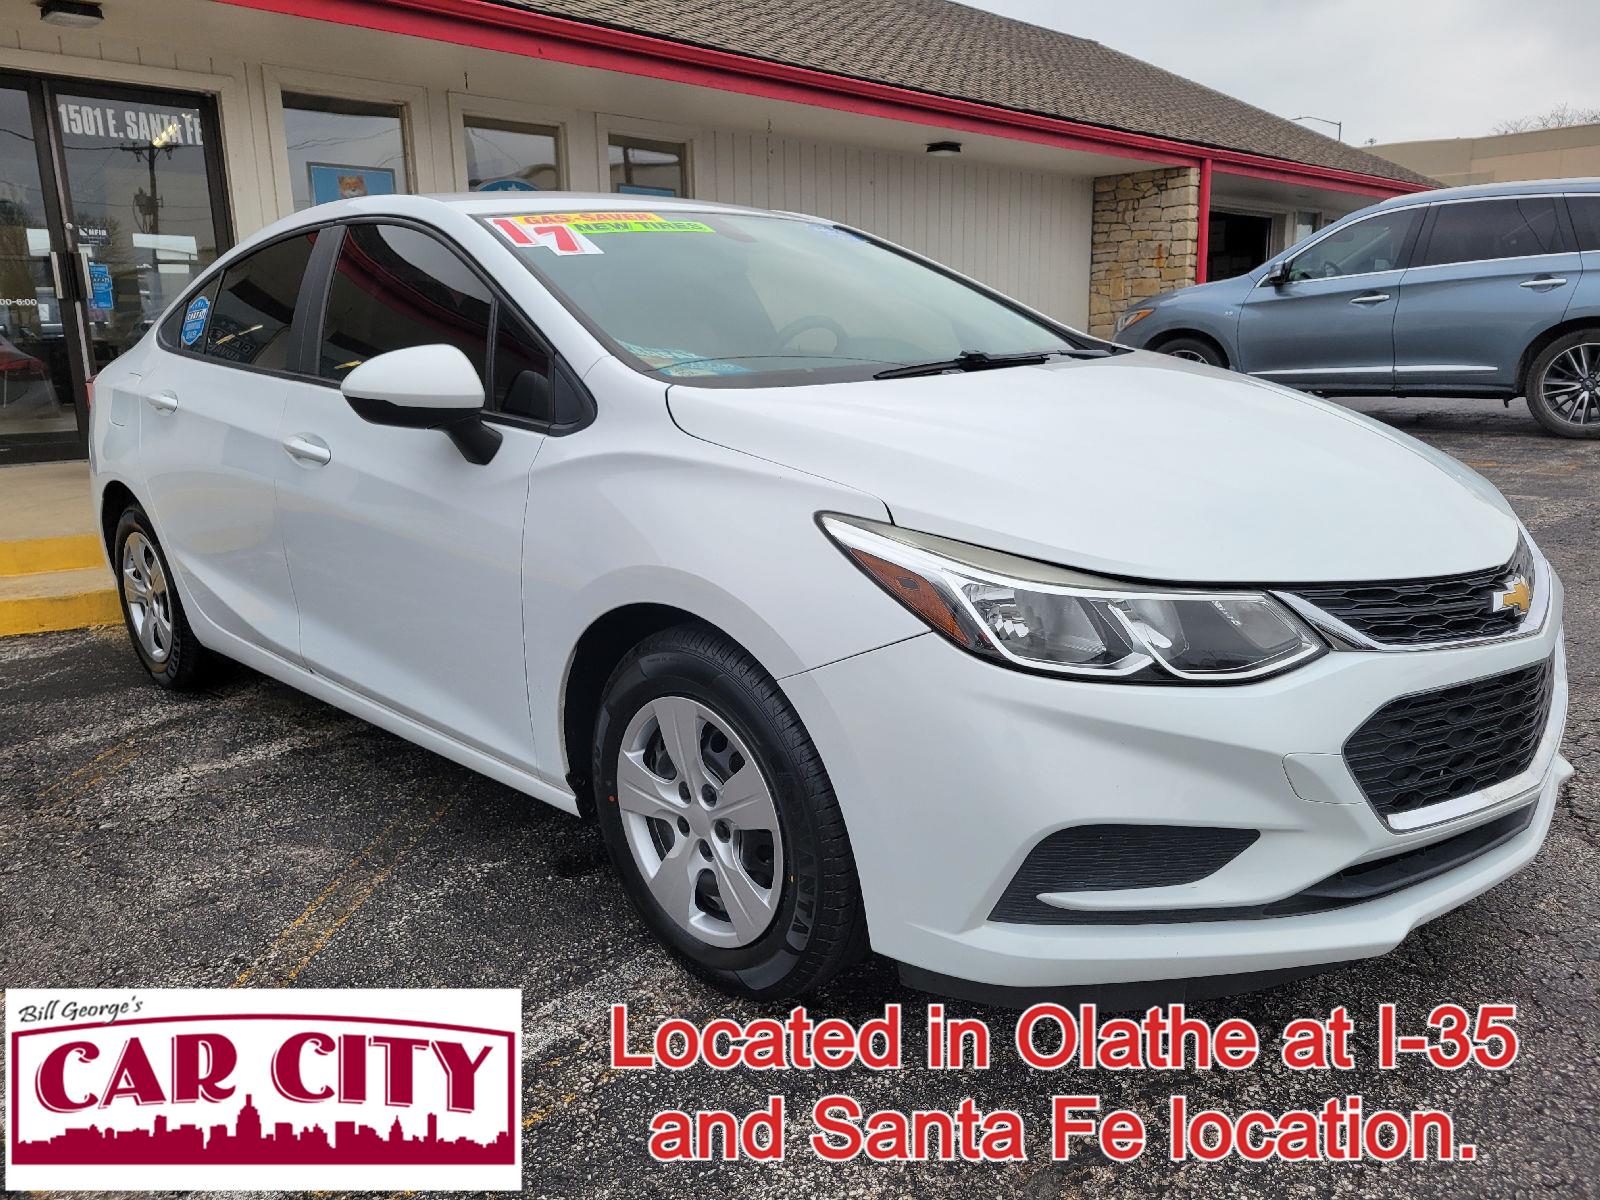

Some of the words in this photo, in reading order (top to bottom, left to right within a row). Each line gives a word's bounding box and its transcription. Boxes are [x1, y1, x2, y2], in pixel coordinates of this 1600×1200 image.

[58, 104, 104, 137] 1501
[106, 108, 124, 138] E.
[125, 110, 183, 144] SANTA
[573, 222, 628, 232] NEW
[640, 221, 702, 232] TIRES
